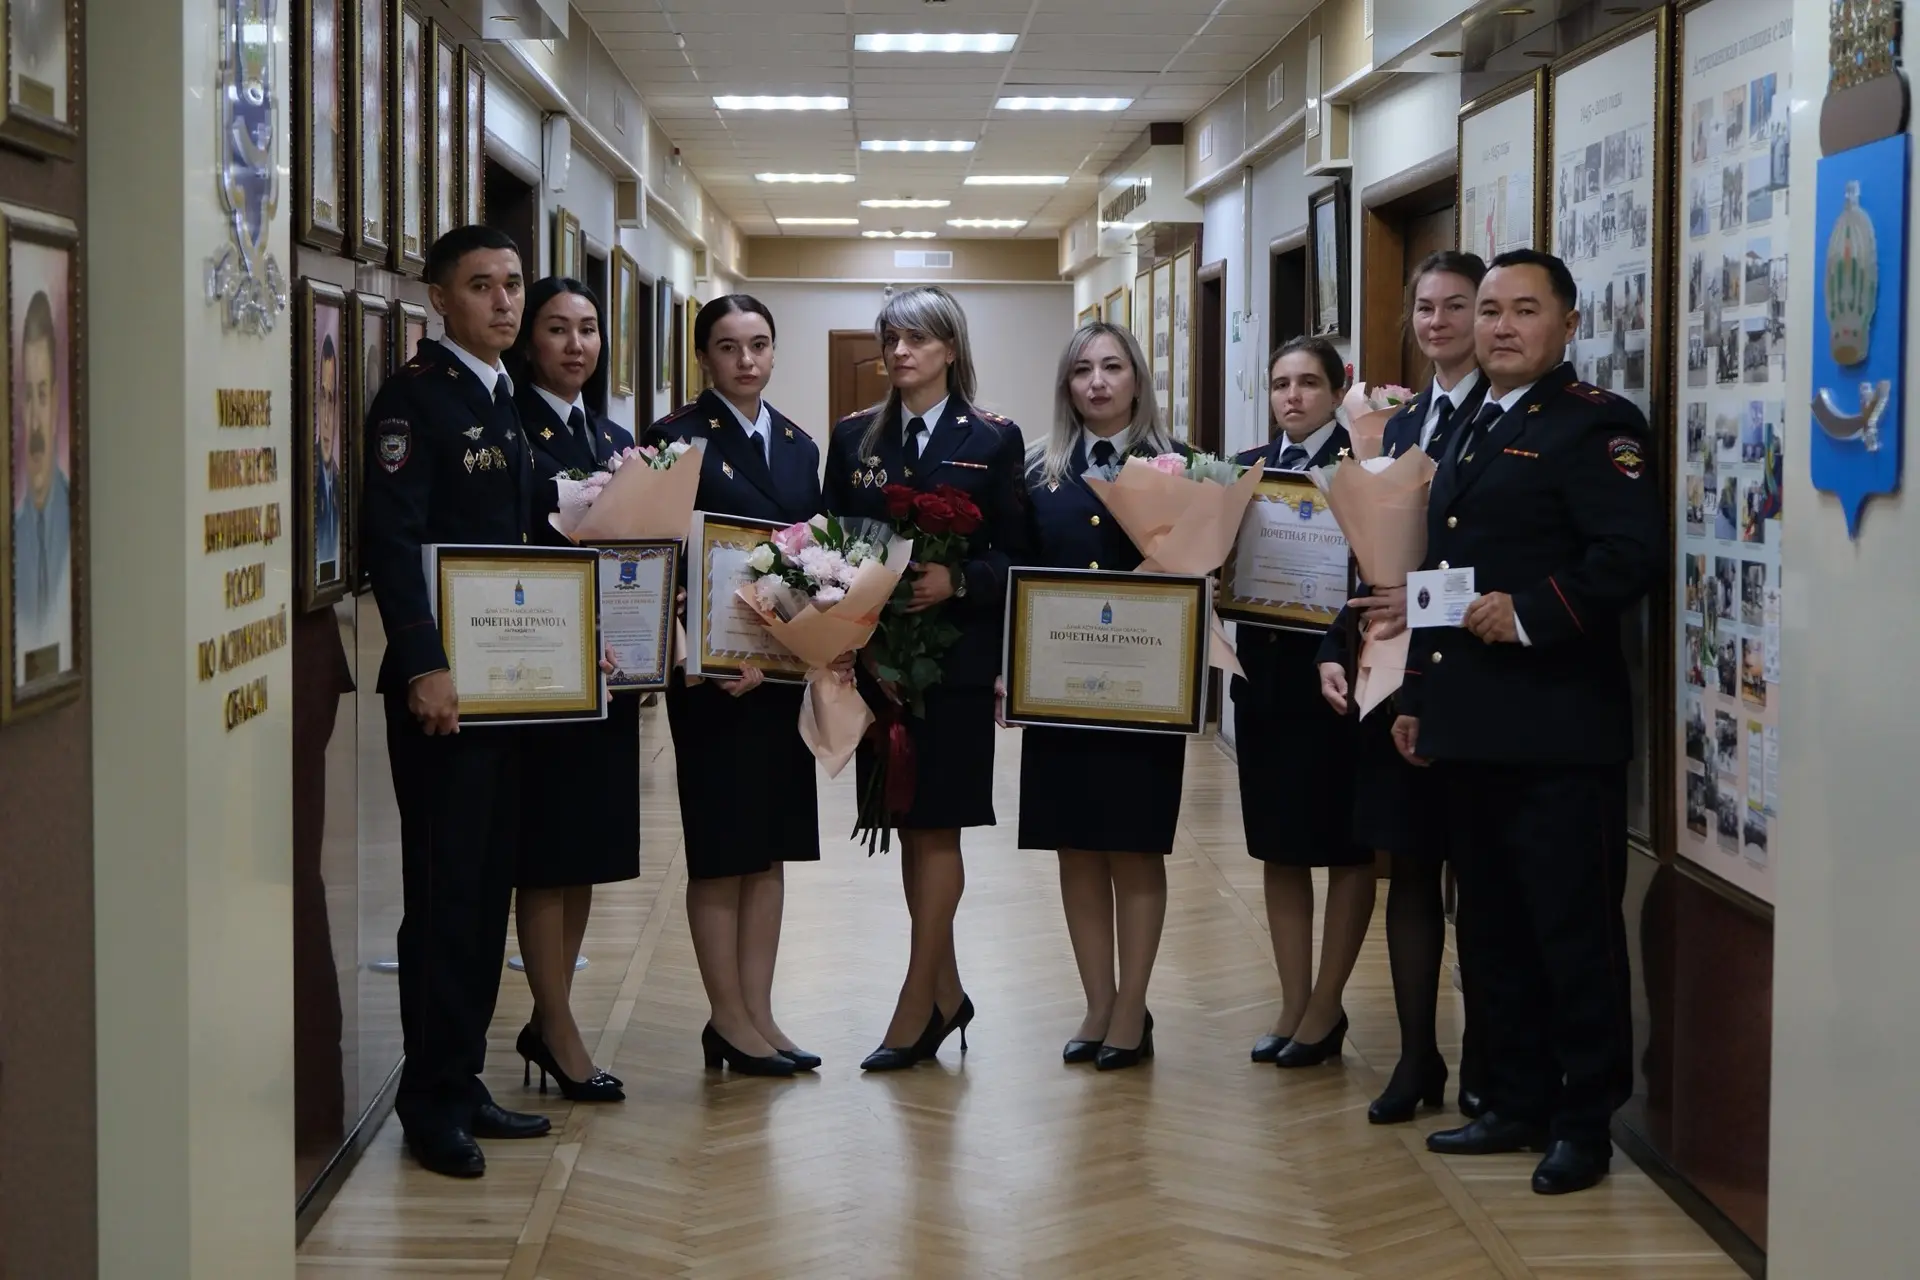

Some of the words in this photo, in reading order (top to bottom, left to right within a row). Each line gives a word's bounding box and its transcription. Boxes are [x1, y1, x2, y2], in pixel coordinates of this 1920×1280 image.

[1260, 527, 1307, 541] ПОЧЕТНАЯ
[1308, 531, 1348, 546] ГРАМОТА
[471, 617, 523, 627] ПОЧЕТНАЯ
[525, 617, 566, 627] ГРАМОТА
[1050, 630, 1109, 643] ПОЧЕТНАЯ
[1112, 633, 1162, 646] ГРАМОТА
[197, 637, 216, 683] ПО
